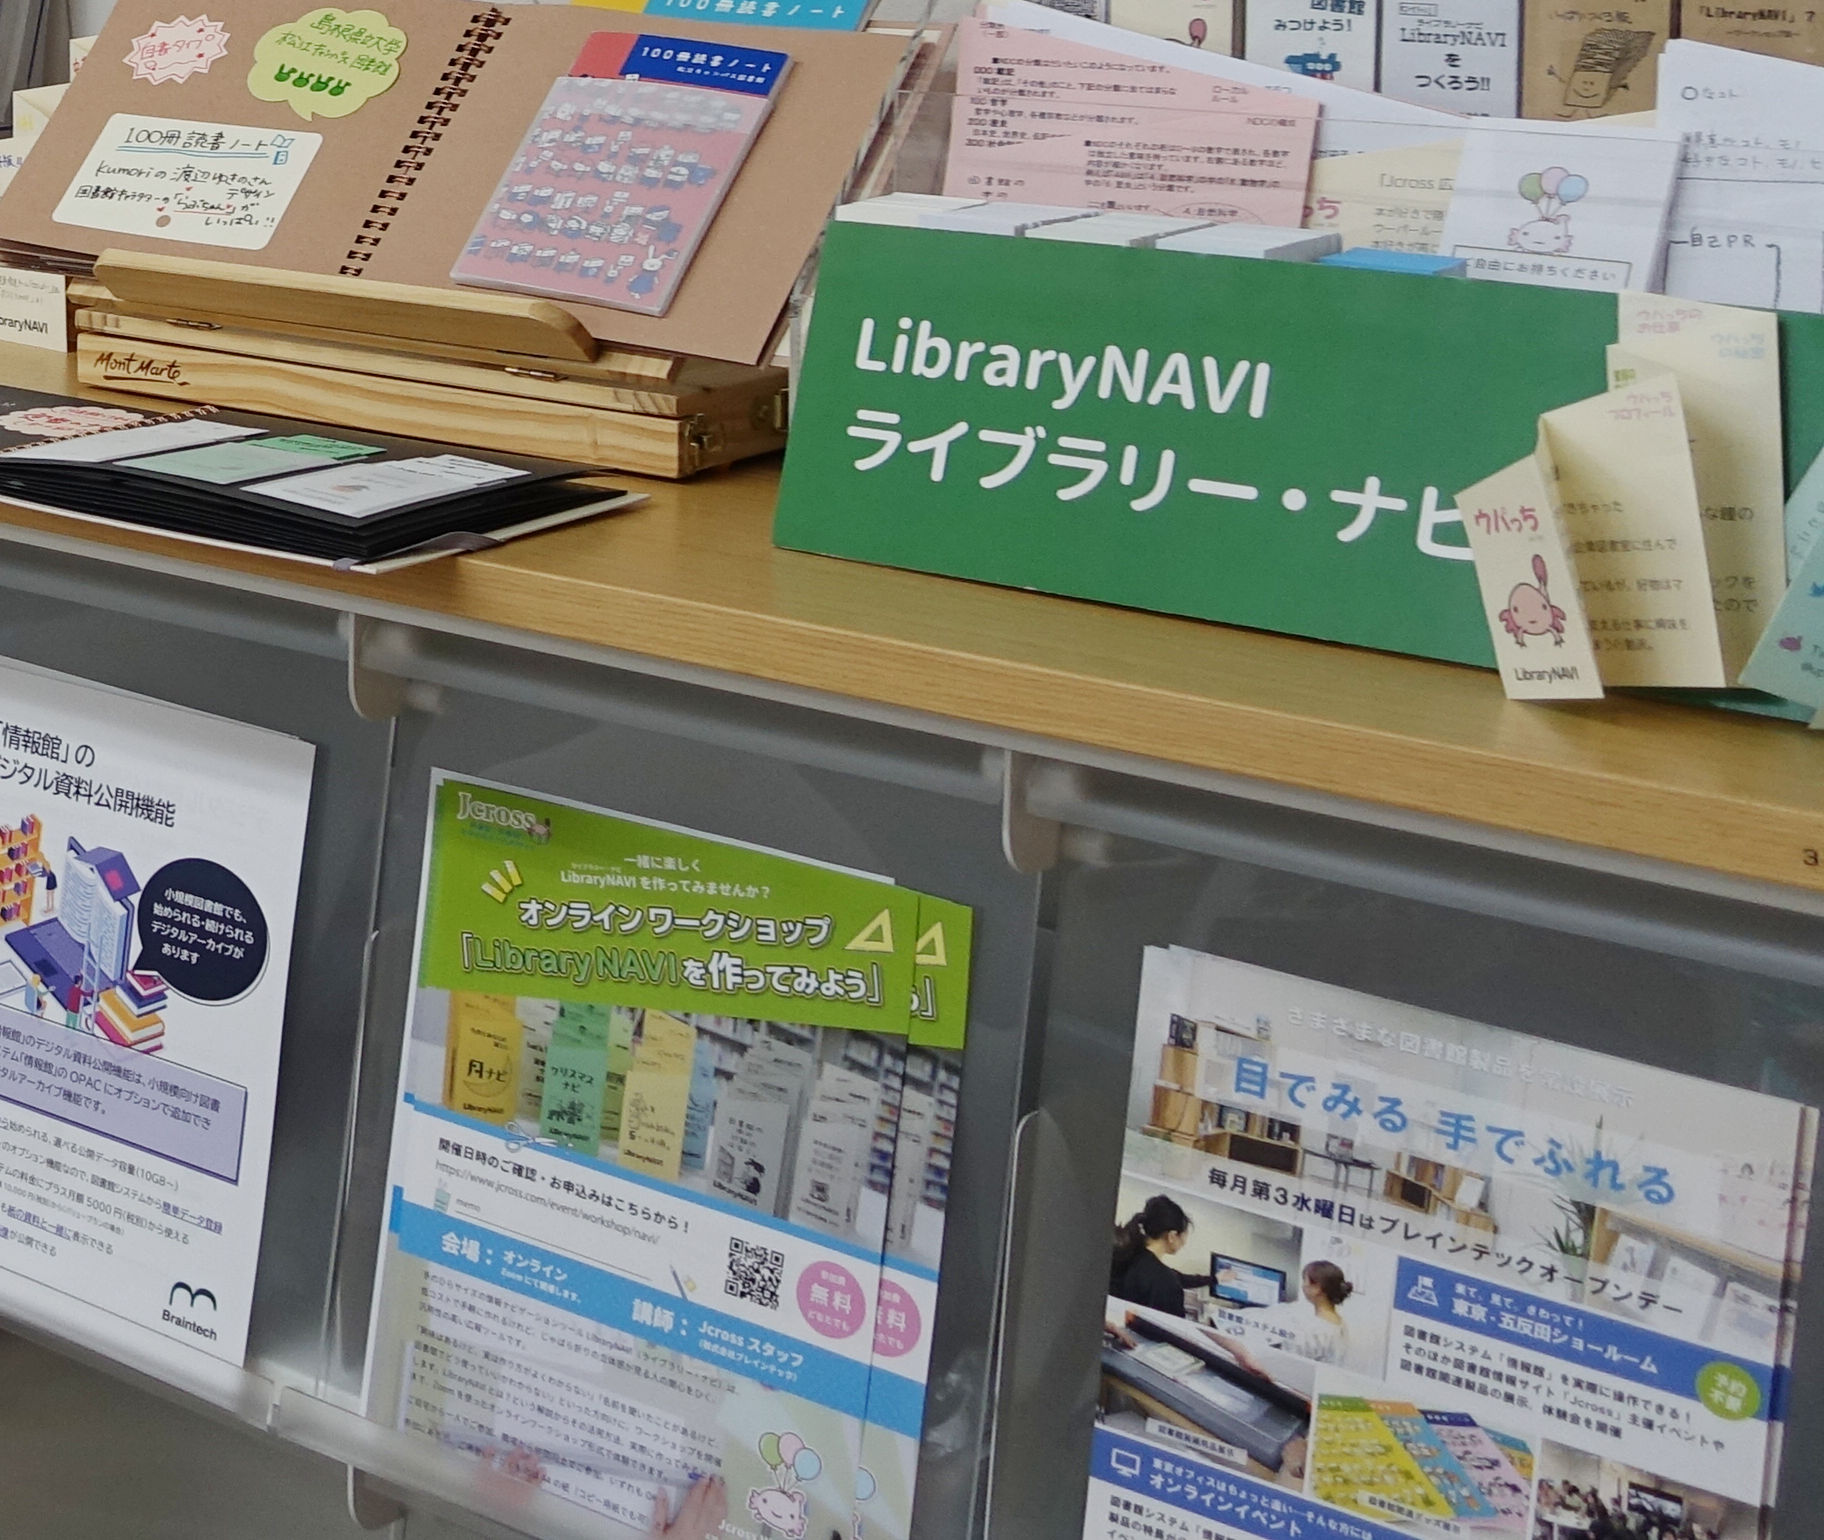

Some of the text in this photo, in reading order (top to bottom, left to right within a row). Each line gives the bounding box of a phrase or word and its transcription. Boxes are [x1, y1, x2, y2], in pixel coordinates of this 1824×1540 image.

[309, 13, 405, 59] 島根県立大学
[1273, 18, 1353, 33] みつけよう!
[1399, 27, 1508, 48] LibraryNAVI
[640, 46, 772, 73] 100冊読書ノート
[1444, 53, 1462, 68] を
[1211, 94, 1238, 104] ルール
[1212, 84, 1250, 96] ローカル
[1690, 227, 1755, 249] 自己PR
[93, 351, 184, 382] Mont Marte
[855, 316, 1273, 420] LibraryNAVI
[1608, 406, 1676, 420] プロフィール
[1474, 504, 1541, 535] ウパっち
[1514, 666, 1580, 684] LibraryNAVI
[457, 791, 536, 831] Jcross
[623, 852, 702, 873] 一緒に楽しく
[163, 886, 248, 927] 小規模図書館でも、
[152, 901, 255, 945] 始められる・続けられる
[149, 919, 246, 961] デジタルアーカイブが
[161, 942, 201, 966] あります
[466, 1059, 508, 1084] 月ナビ
[551, 1067, 594, 1084] クリスマス
[561, 1081, 580, 1094] ナビ
[1232, 1054, 1678, 1207] 目でみる 手でふれる
[437, 1136, 691, 1235] 開催日時のご確認・お申込みはこちらから！
[1207, 1165, 1684, 1318] 毎月第3水曜日はブレインテックオープンデー
[501, 1247, 569, 1282] オンライン
[808, 1282, 854, 1314] 無料
[161, 1308, 218, 1342] Braintech
[806, 1309, 851, 1333] どなたでも
[1451, 1296, 1660, 1376] 東京・五反田ショールーム
[1403, 1323, 1693, 1424] 図書館システム「情報館」を実際に操作できる！
[1712, 1371, 1747, 1398] 予約
[1709, 1386, 1744, 1414] 不要
[1149, 1470, 1303, 1538] オンラインイベント
